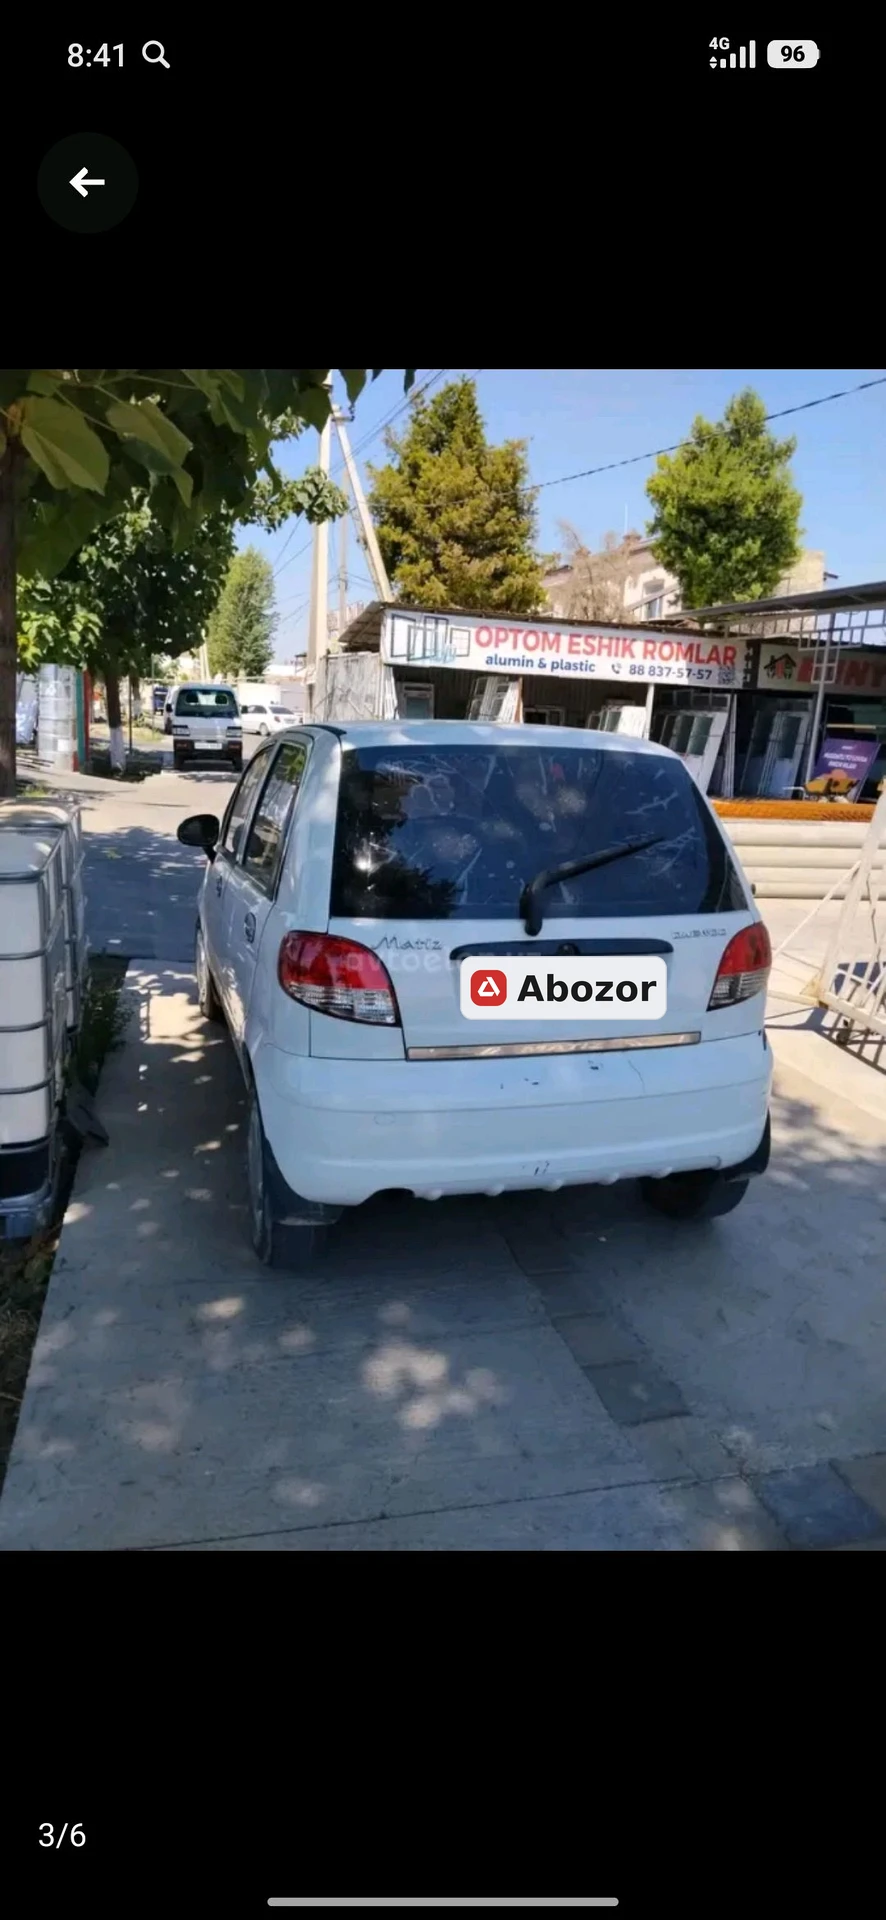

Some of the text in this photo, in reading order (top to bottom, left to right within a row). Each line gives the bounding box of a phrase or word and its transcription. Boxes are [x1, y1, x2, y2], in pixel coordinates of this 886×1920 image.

[475, 626, 737, 666] OPTOM ESHIK ROMLAR
[485, 653, 596, 673] alumin & plastic
[629, 664, 713, 680] 88 837-57-57
[372, 935, 444, 951] Matiz
